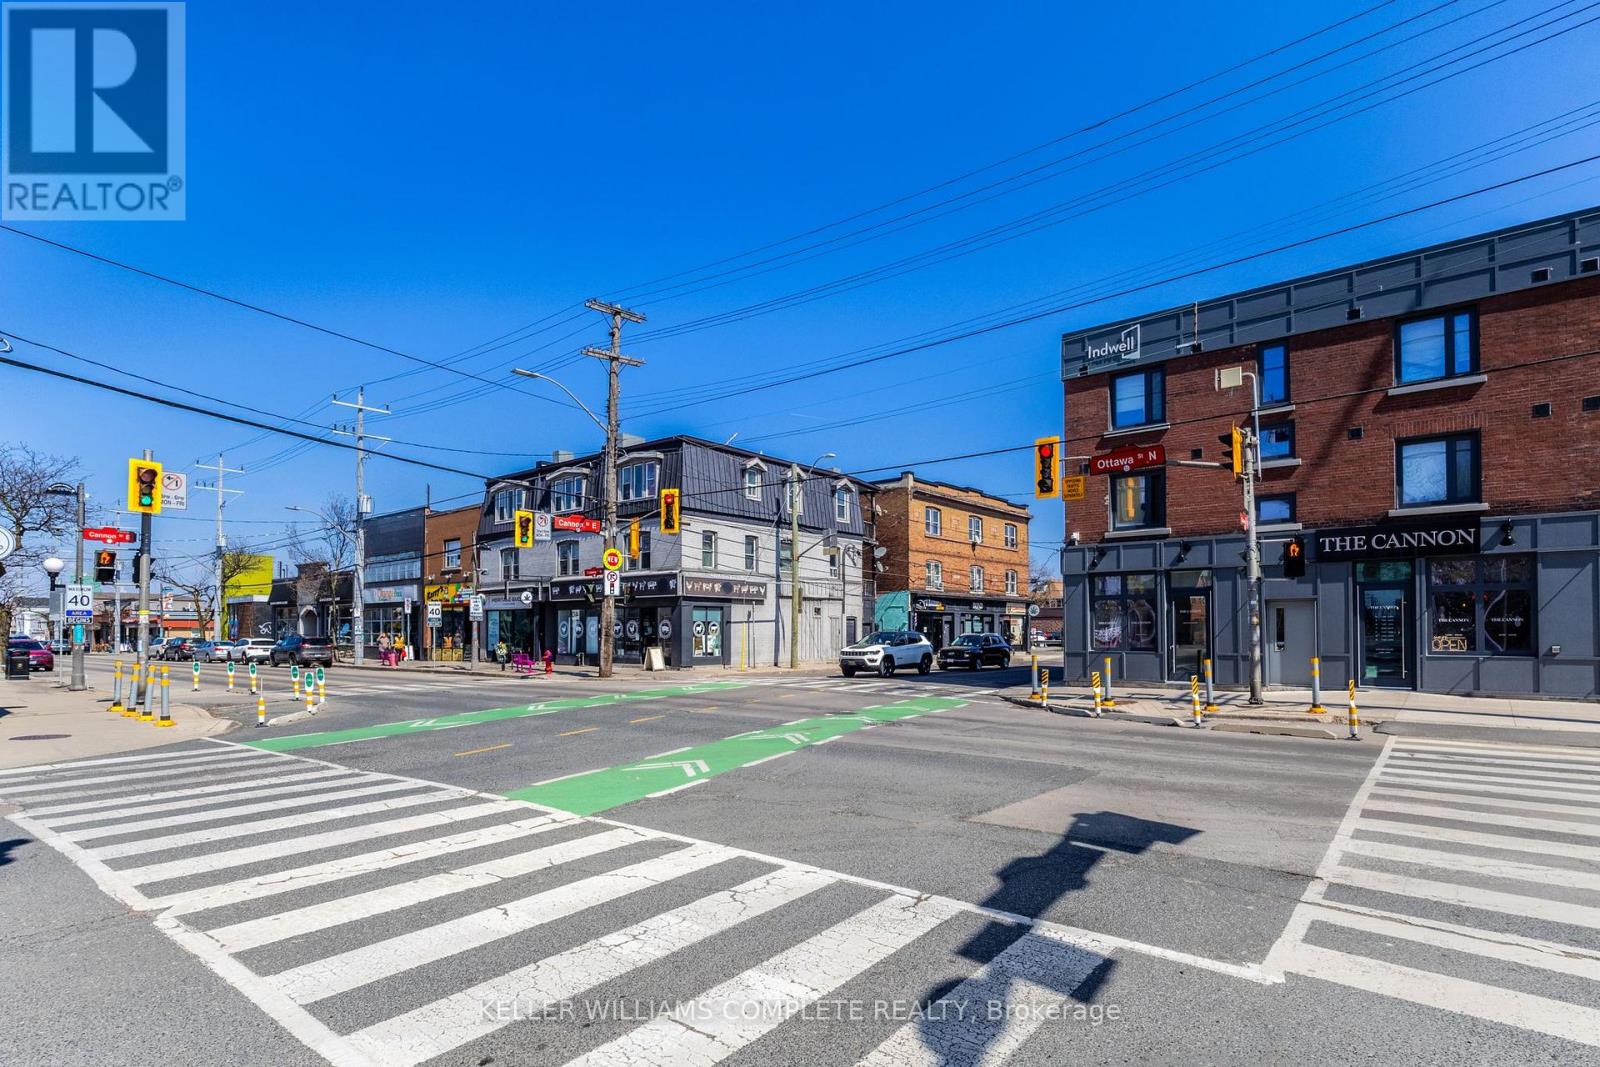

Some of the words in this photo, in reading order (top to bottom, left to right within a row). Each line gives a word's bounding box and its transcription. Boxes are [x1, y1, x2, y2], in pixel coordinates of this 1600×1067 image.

[1088, 336, 1134, 359] Indwell
[1097, 456, 1134, 469] Ottawa
[1148, 450, 1157, 461] N
[558, 519, 584, 528] Cannon
[88, 531, 117, 539] Cannon
[1320, 535, 1367, 552] THE
[1371, 528, 1476, 550] CANNON
[68, 595, 90, 606] 40
[429, 608, 441, 616] 40
[1431, 639, 1467, 651] OPEN
